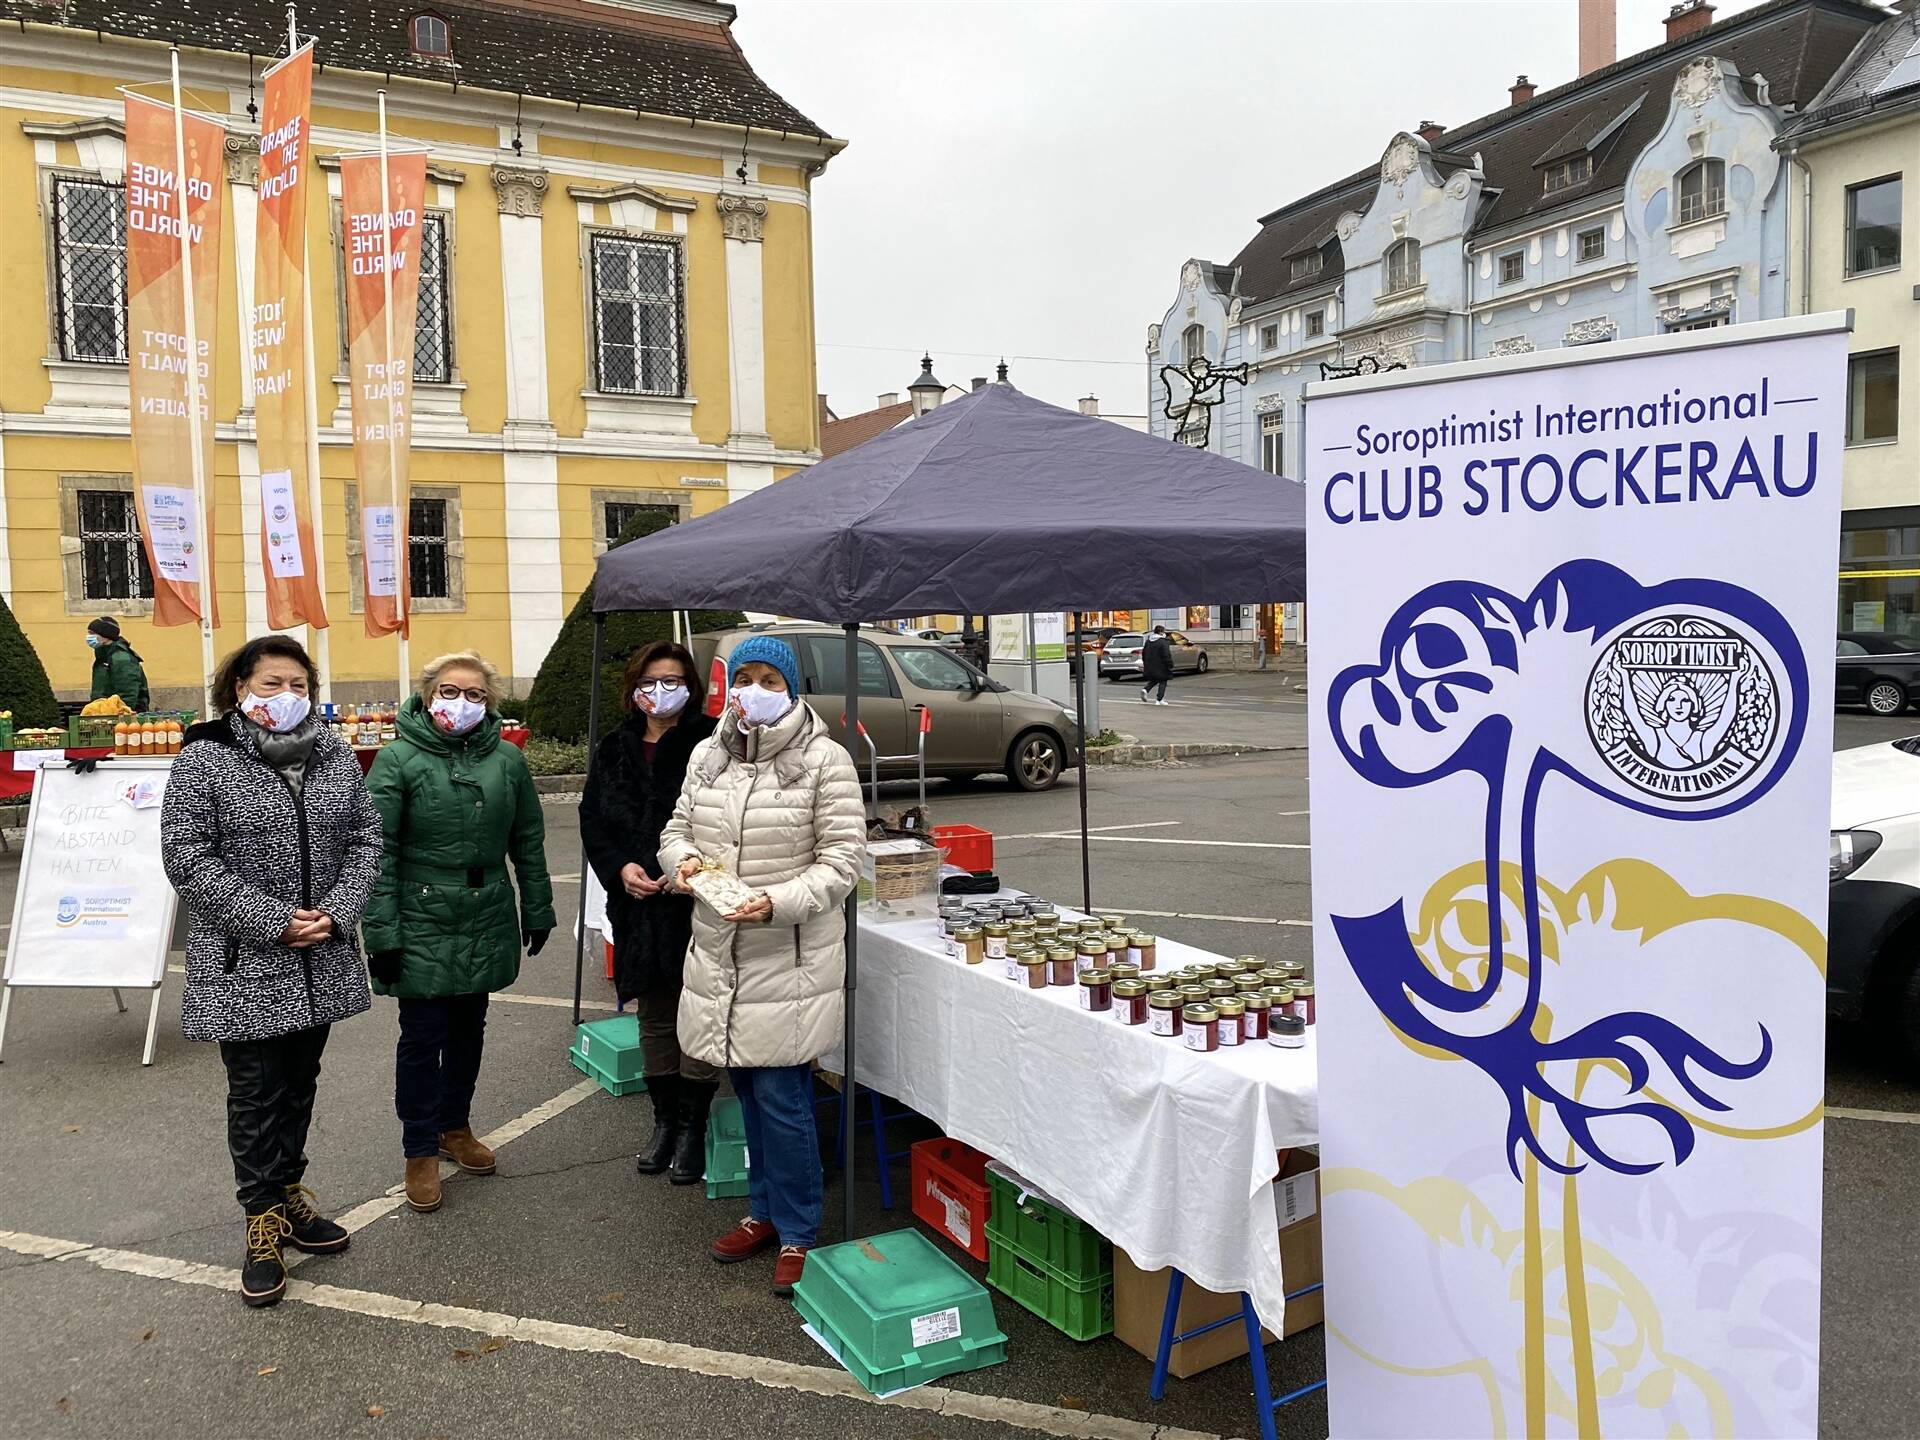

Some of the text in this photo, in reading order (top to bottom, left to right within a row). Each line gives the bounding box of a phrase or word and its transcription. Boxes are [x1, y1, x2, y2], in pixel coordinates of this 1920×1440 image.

[282, 139, 300, 168] THE
[1357, 377, 1768, 457] Soroptimist International
[1324, 432, 1819, 525] CLUB STOCKERAU
[1621, 642, 1739, 667] SOROPTIMIST
[1610, 749, 1745, 792] INTERNATIONAL
[60, 803, 116, 826] BITTE
[54, 830, 137, 849] ABSTAND
[51, 858, 122, 875] HALTEN
[85, 897, 131, 905] SOROPTIMIST
